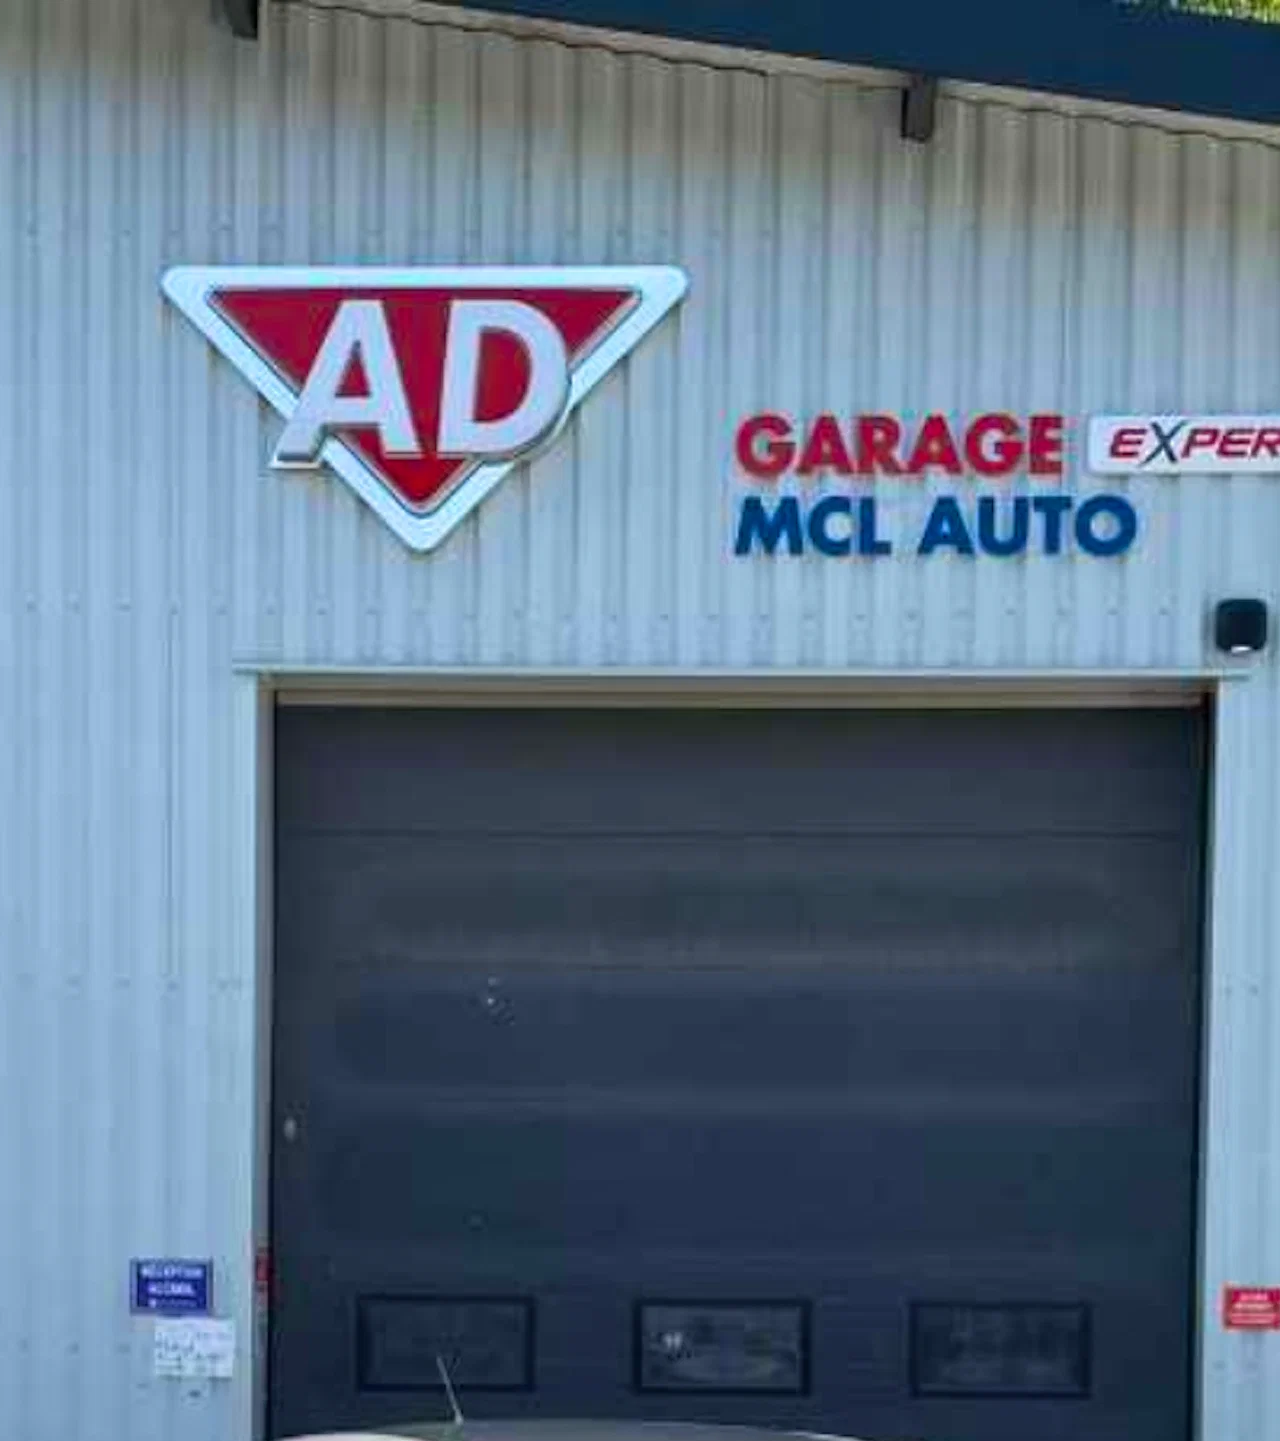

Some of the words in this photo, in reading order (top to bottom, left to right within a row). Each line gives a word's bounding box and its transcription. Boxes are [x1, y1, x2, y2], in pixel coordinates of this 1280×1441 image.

[271, 298, 570, 468] AD
[736, 414, 1065, 475] GARAGE
[734, 495, 891, 556] MCL
[917, 494, 1137, 557] AUTO
